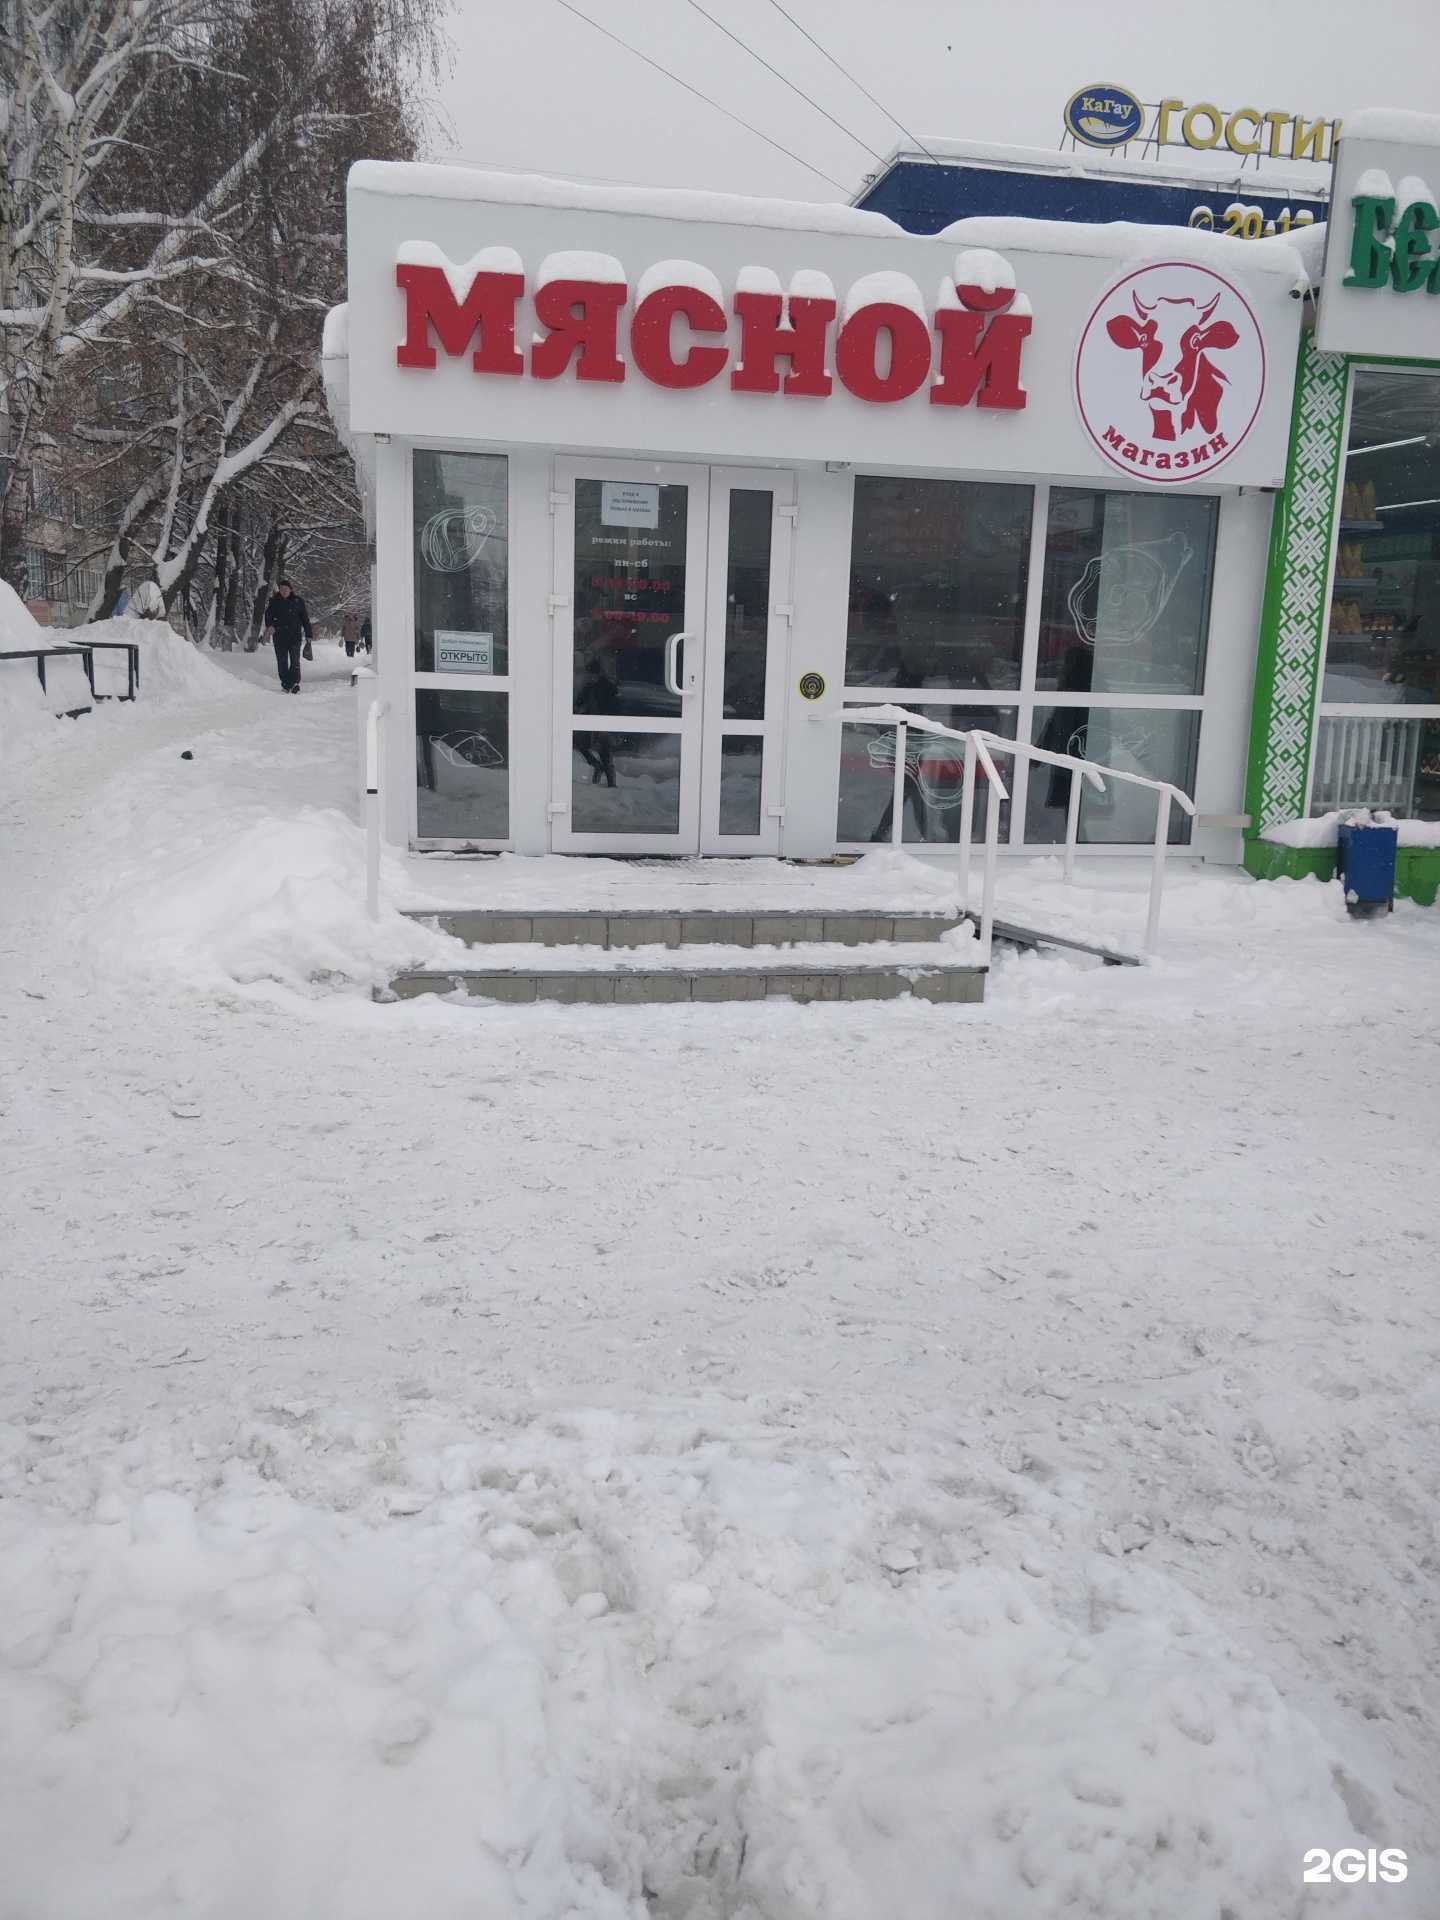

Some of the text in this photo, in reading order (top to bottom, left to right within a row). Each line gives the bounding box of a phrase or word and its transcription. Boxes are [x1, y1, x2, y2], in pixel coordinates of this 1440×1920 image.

[1082, 96, 1134, 120] КаГау
[395, 262, 1032, 411] МЯСНОЙ
[1102, 424, 1229, 470] магазин
[592, 536, 627, 546] режим
[614, 558, 648, 568] пн-сб
[440, 651, 488, 663] ОТКРЫТО
